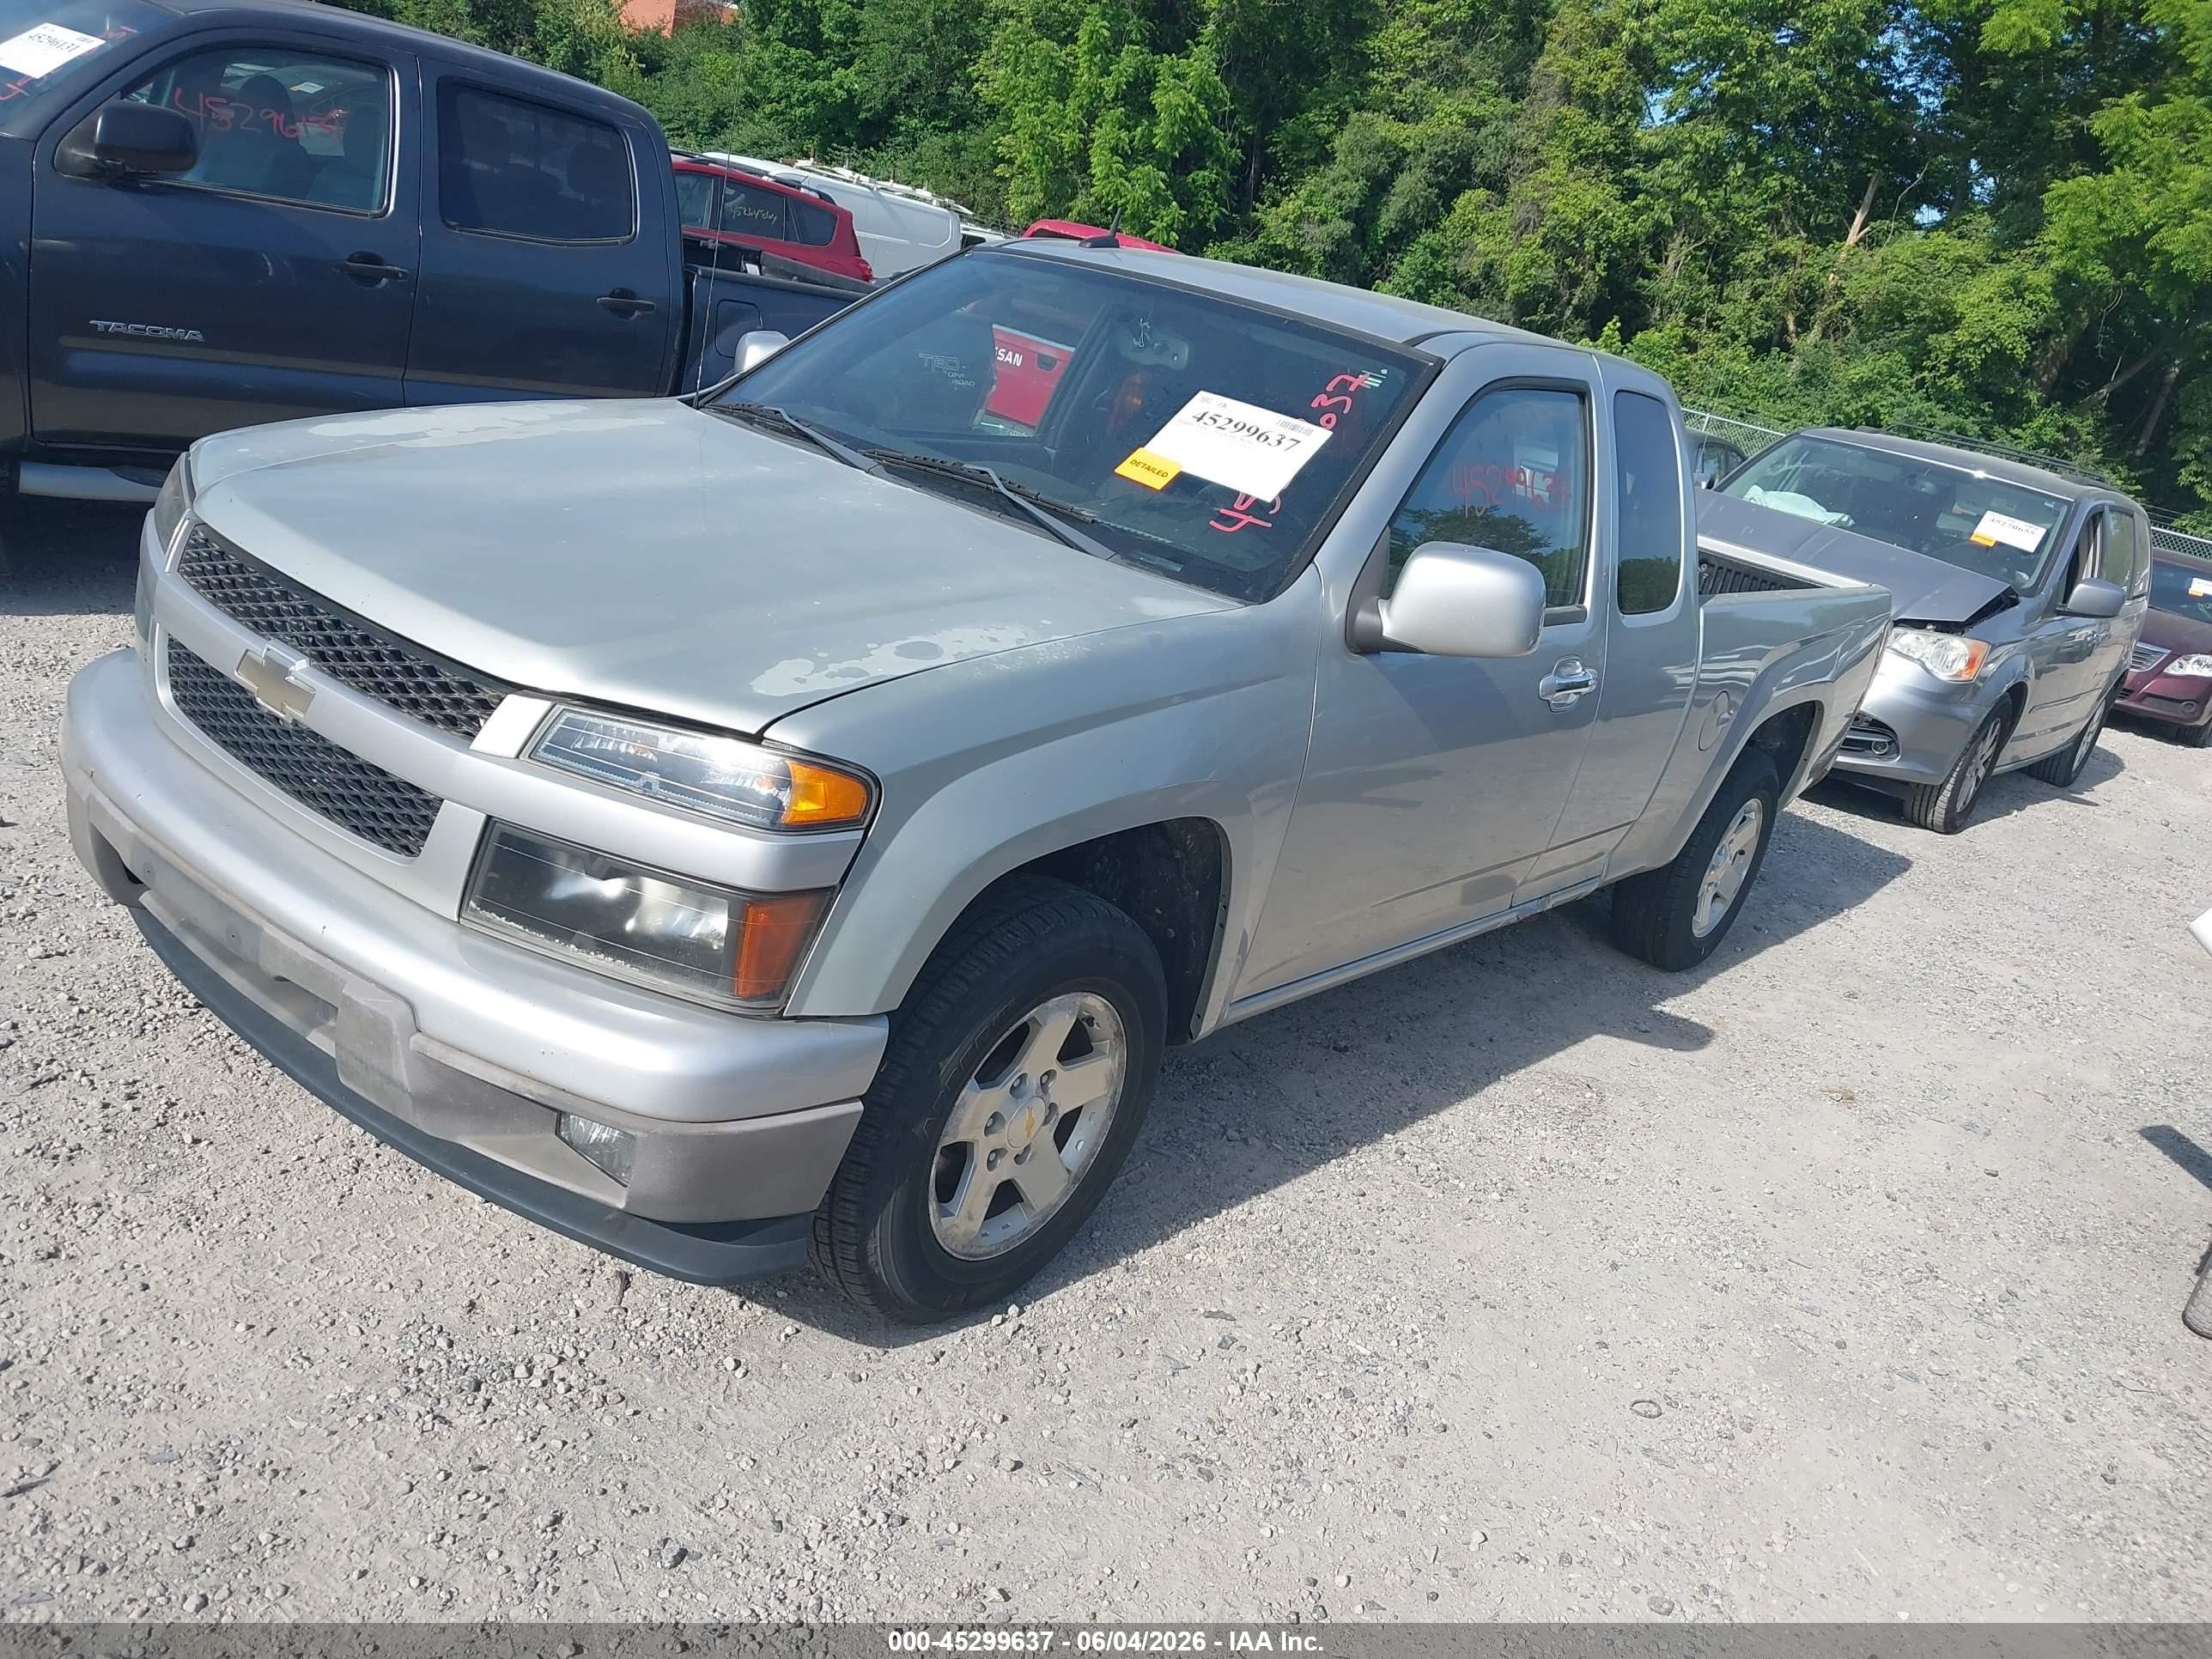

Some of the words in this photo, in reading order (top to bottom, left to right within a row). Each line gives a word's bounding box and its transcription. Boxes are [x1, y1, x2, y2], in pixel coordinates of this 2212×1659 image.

[88, 319, 205, 342] TACOMA
[919, 353, 960, 374] TRD
[1192, 410, 1301, 452] 45299637
[1130, 459, 1169, 477] DETAILED
